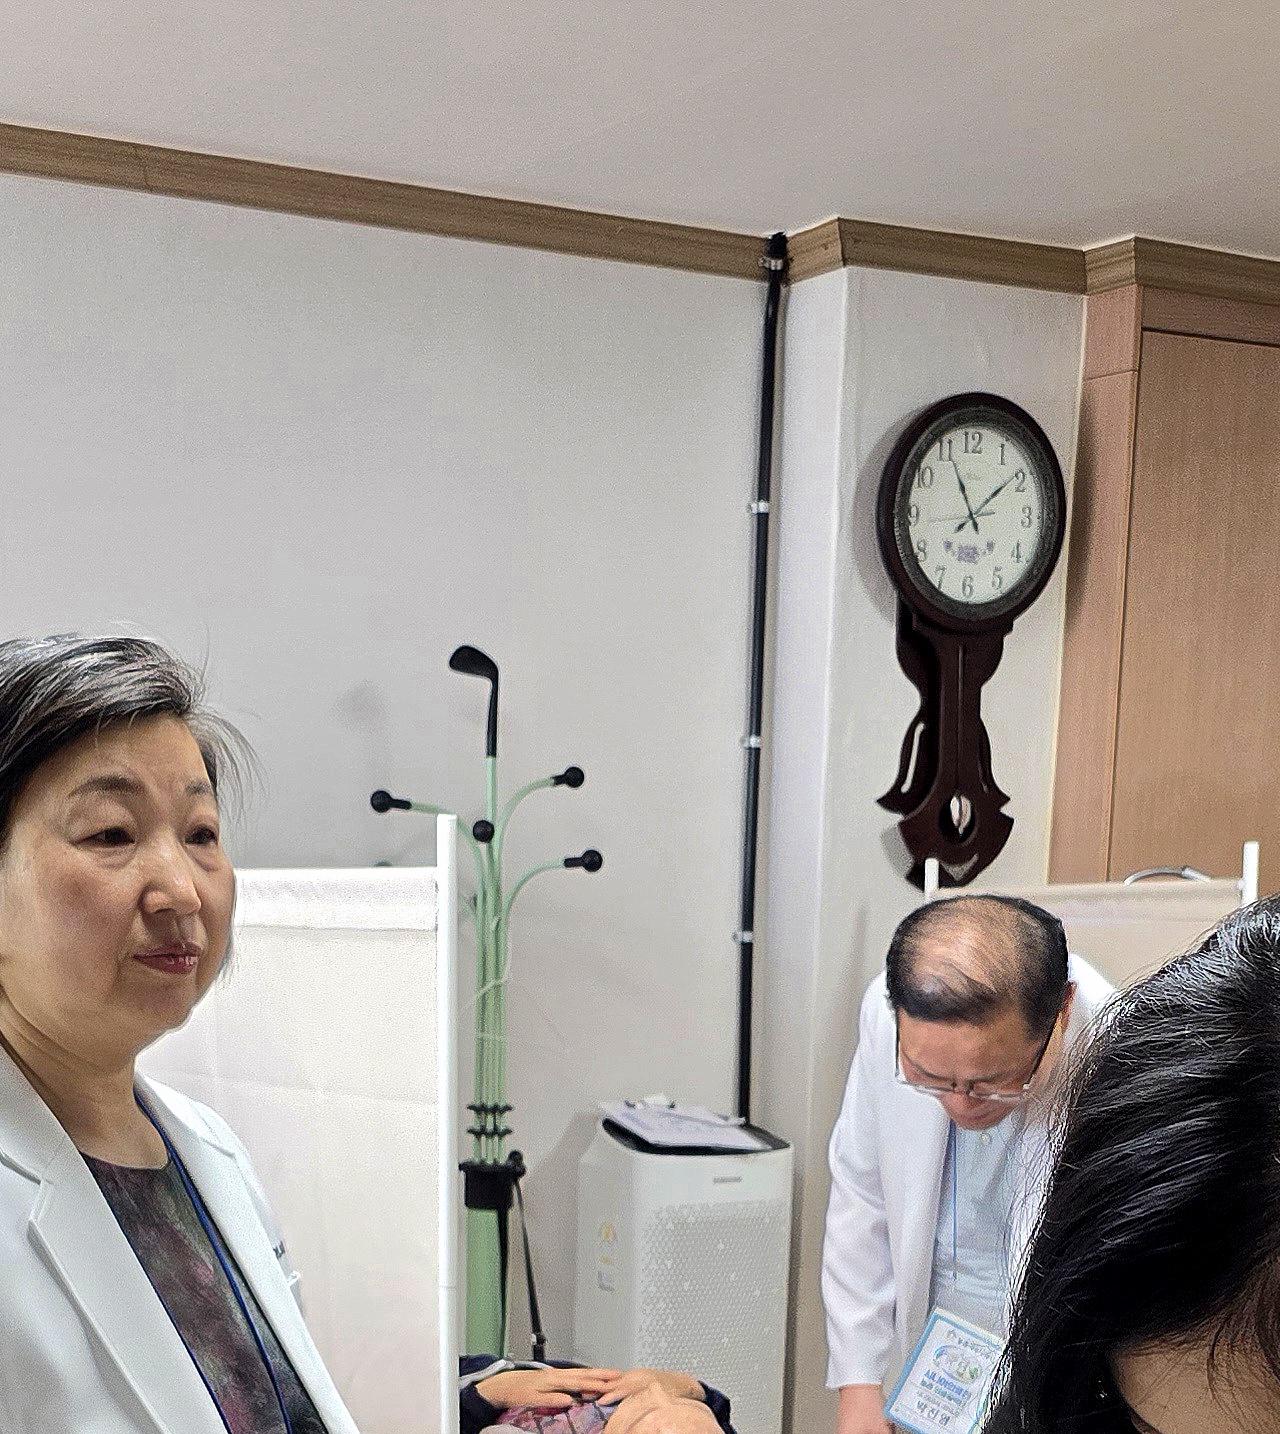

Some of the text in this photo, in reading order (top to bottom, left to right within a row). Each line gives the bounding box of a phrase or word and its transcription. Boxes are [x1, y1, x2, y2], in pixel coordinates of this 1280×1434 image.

[937, 438, 953, 462] 11
[963, 430, 983, 454] 12
[999, 443, 1006, 466] 1
[916, 466, 934, 489] 10
[1014, 469, 1026, 492] 2
[908, 504, 919, 526] 9
[1021, 506, 1032, 528] 3
[962, 575, 973, 598] 6
[992, 566, 1003, 590] 5
